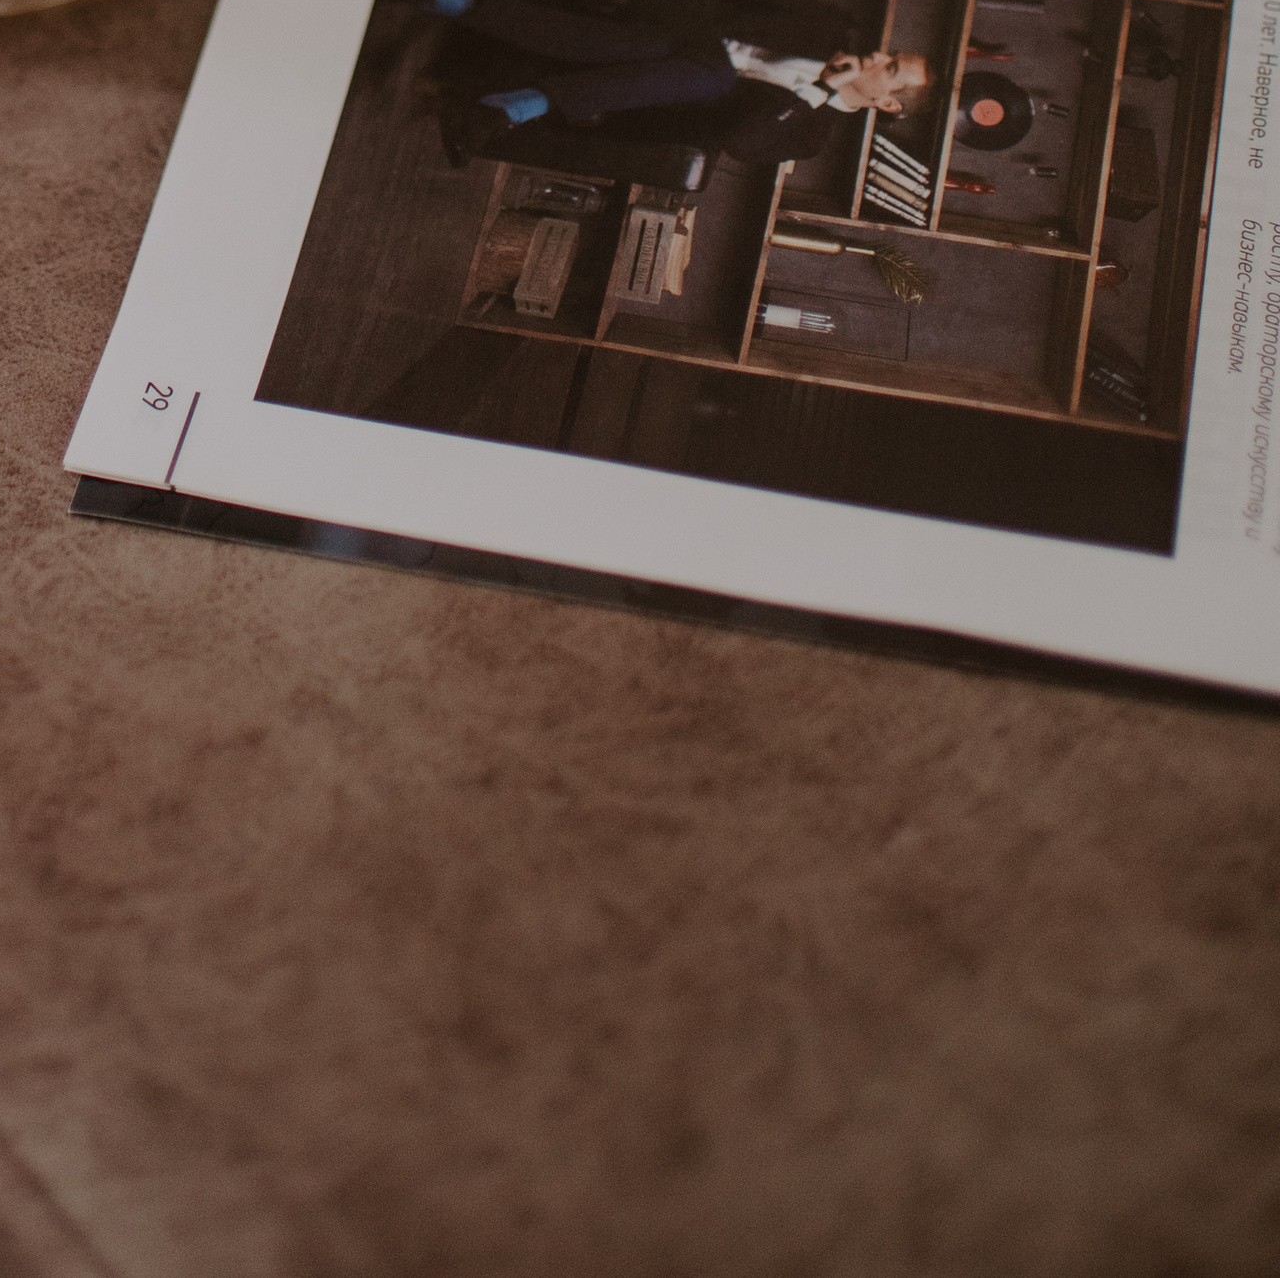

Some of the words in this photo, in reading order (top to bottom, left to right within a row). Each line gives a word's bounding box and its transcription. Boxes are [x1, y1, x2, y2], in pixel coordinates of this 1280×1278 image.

[1260, 13, 1278, 48] лет.
[1248, 51, 1280, 142] Наверное,
[1248, 146, 1264, 170] не
[1227, 218, 1263, 375] бизнес-навыкам.
[142, 381, 174, 411] 29
[1252, 291, 1280, 422] ораторскому
[1242, 424, 1270, 524] искусству
